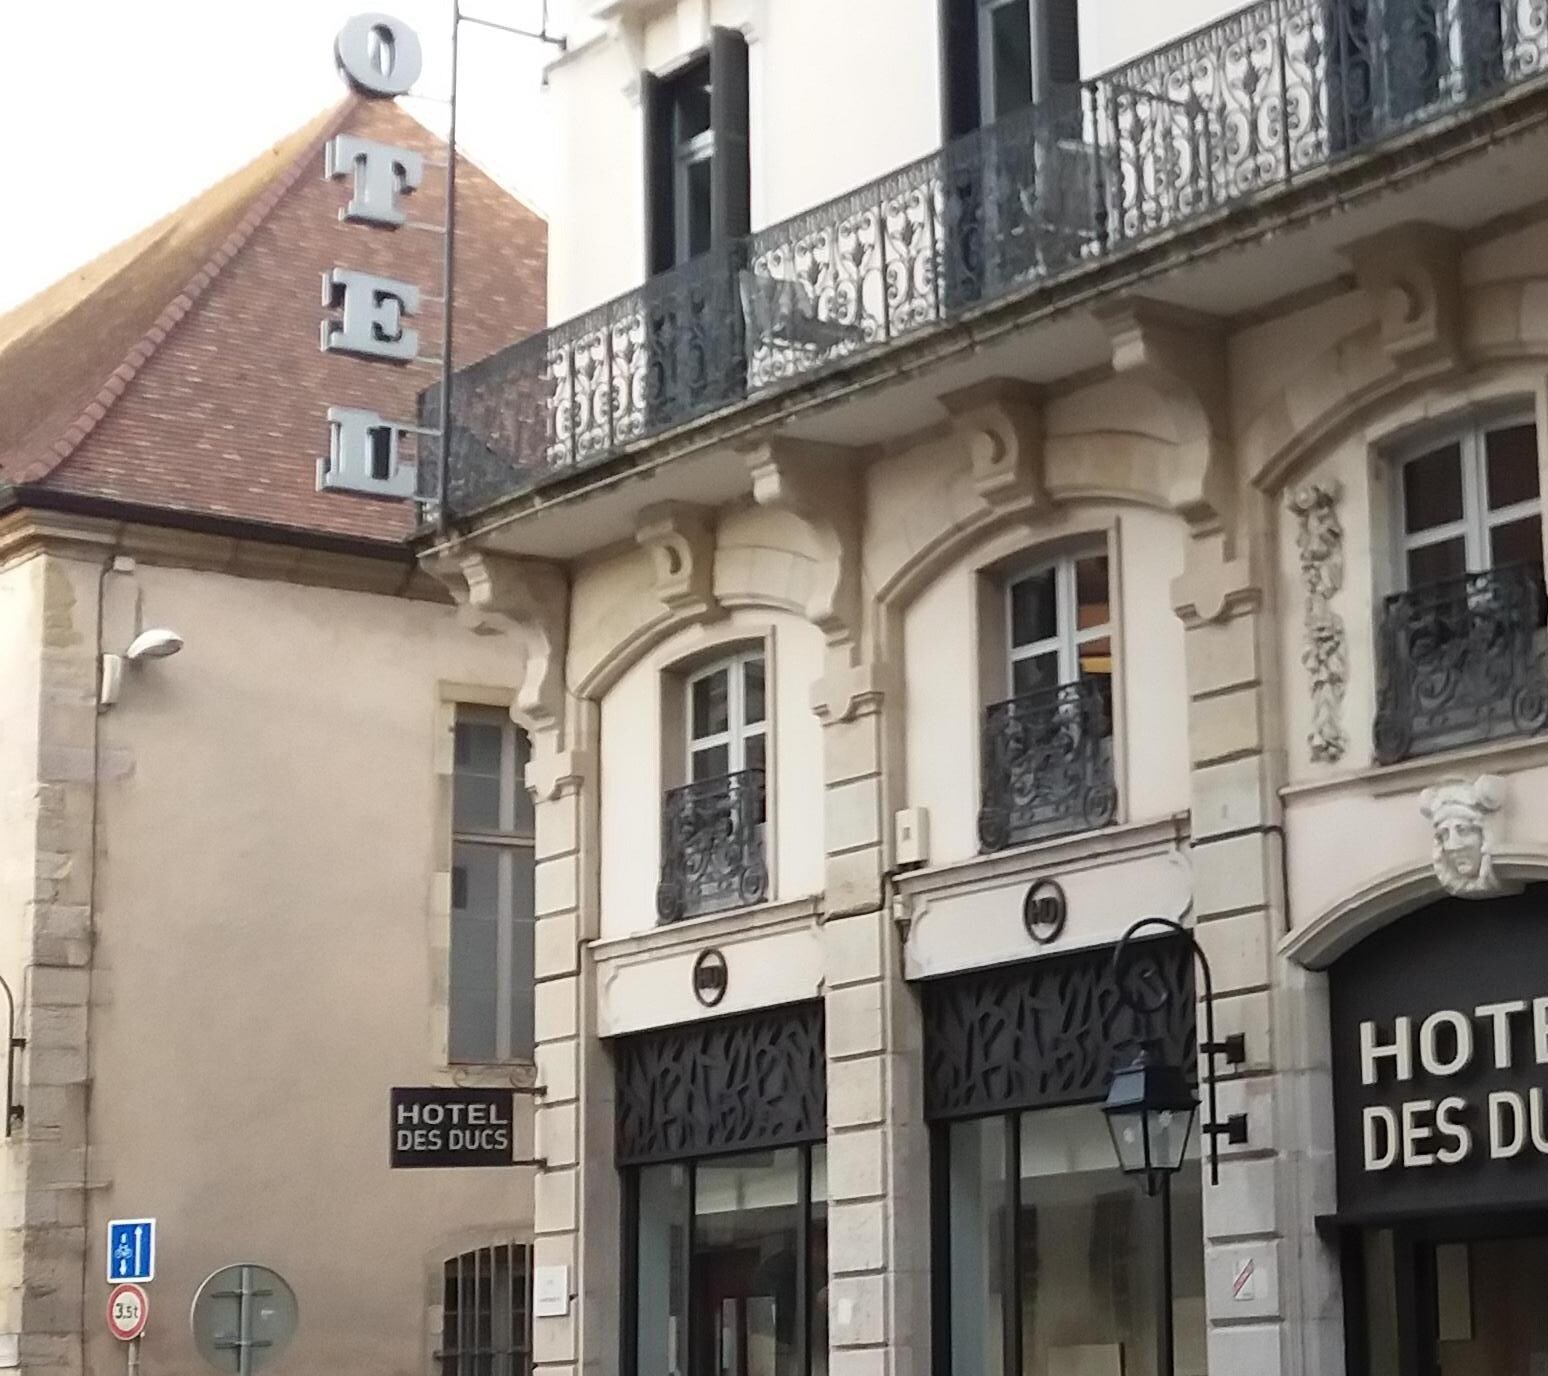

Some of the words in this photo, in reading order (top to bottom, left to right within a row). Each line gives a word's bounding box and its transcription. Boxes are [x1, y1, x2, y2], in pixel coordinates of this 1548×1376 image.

[397, 1104, 508, 1125] HOTEL
[397, 1129, 442, 1150] DES
[448, 1128, 508, 1150] DUCS
[1362, 1096, 1473, 1171] DES
